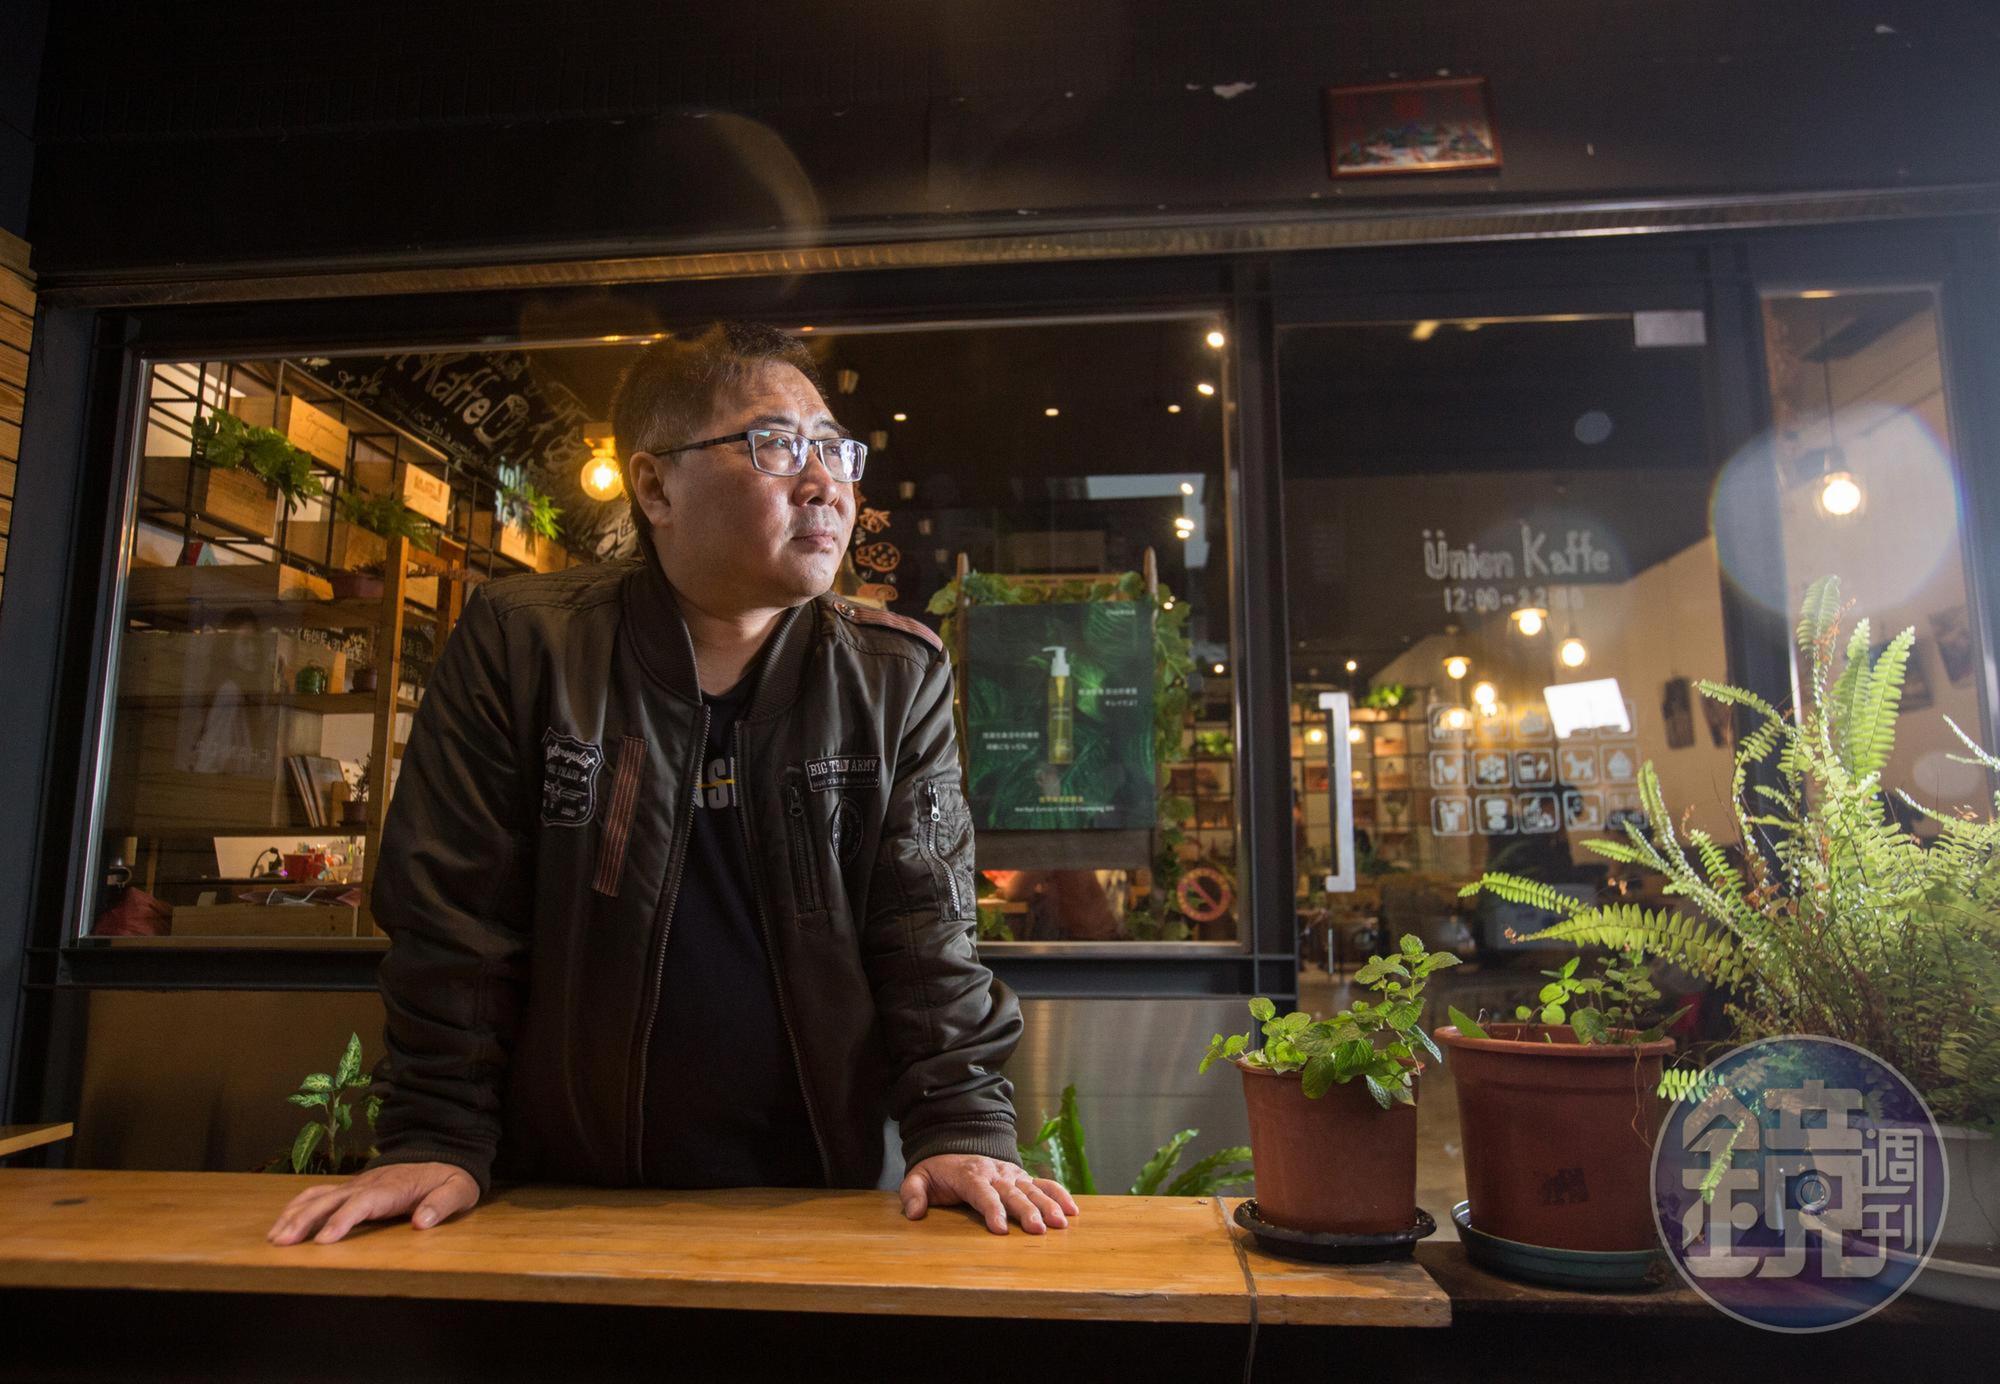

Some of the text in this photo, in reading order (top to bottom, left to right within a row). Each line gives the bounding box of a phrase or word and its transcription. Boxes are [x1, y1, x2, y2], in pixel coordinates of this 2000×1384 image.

[1422, 522, 1610, 579] Ünion Kaffe
[808, 761, 828, 777] BIG
[850, 759, 877, 772] ARMY
